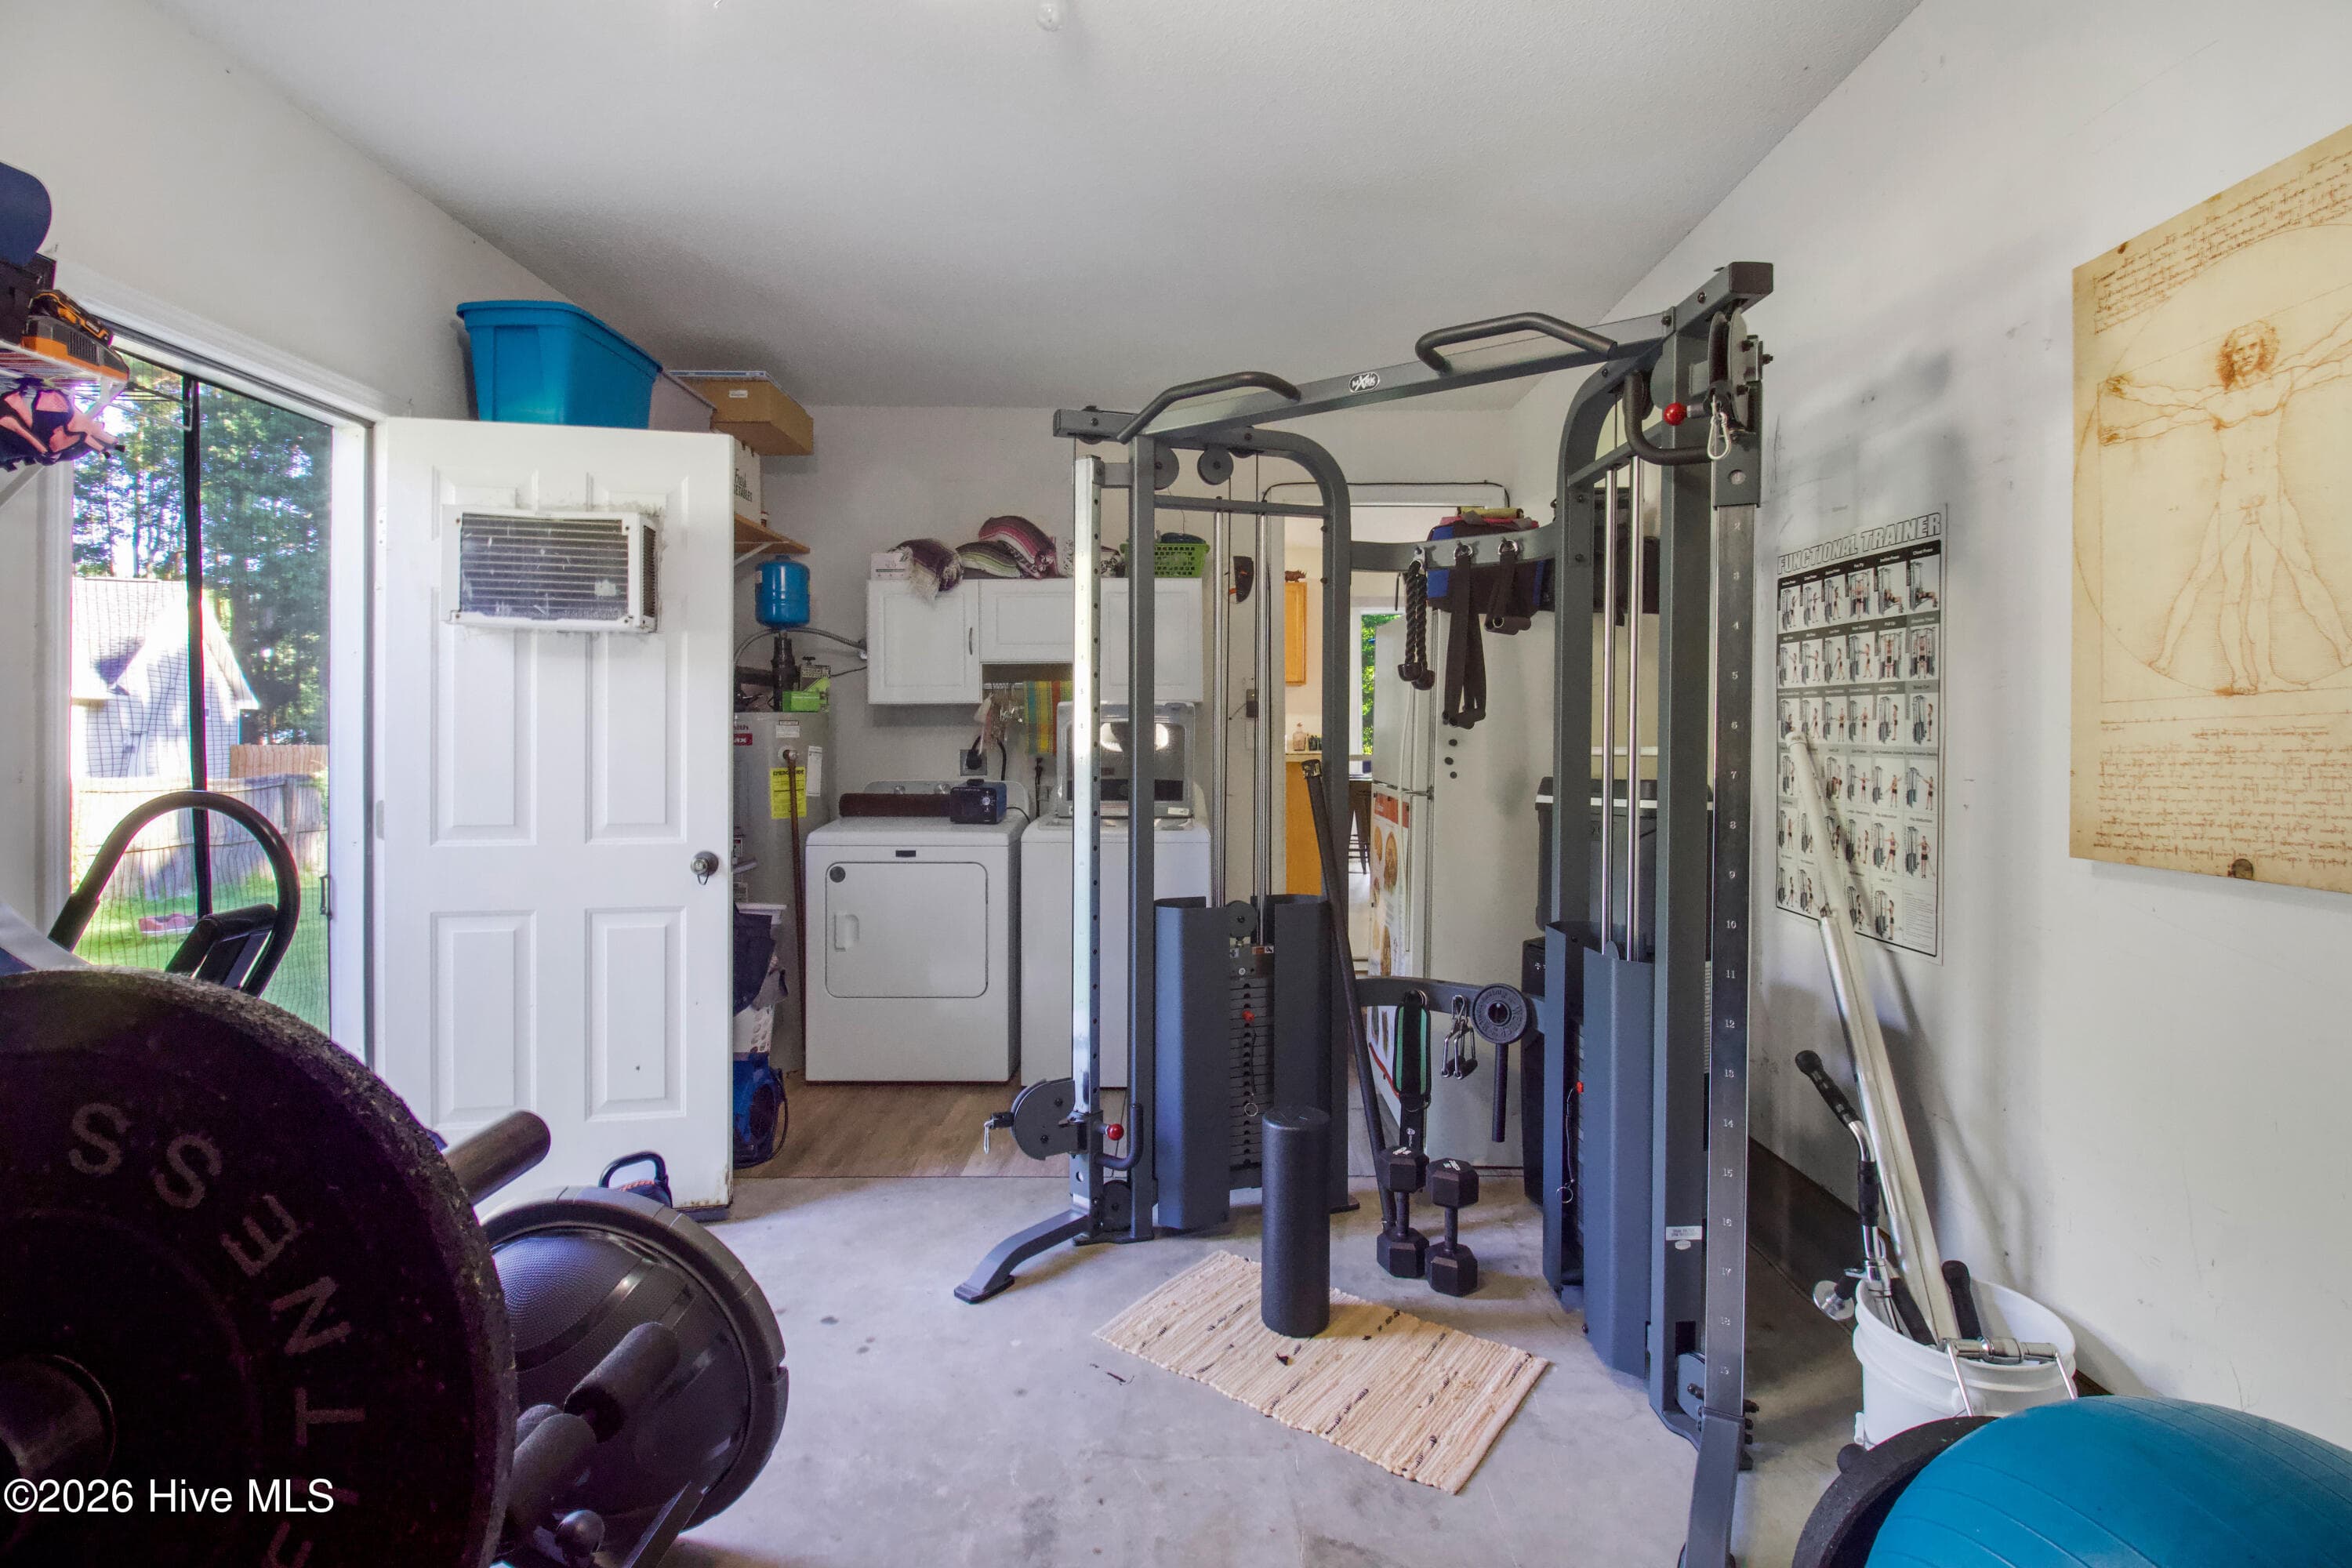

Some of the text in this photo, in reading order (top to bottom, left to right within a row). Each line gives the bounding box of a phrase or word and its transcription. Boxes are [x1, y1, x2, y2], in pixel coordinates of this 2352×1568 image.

[1733, 522, 1741, 531] 2
[1777, 513, 1941, 575] FUNCTIONAL TRAINER
[1733, 572, 1740, 581] 3
[1732, 622, 1740, 630] 4
[1731, 670, 1739, 680] 5
[1731, 720, 1739, 730] 6
[1730, 771, 1737, 779] 7
[1730, 820, 1737, 829] 8
[1729, 870, 1736, 880] 9
[1726, 920, 1737, 930] 10
[1726, 969, 1736, 979] 11
[1725, 1019, 1736, 1029] 12
[1724, 1069, 1735, 1078] 13
[1722, 1118, 1733, 1128] 14
[1722, 1167, 1733, 1178] 15
[1722, 1218, 1733, 1227] 16
